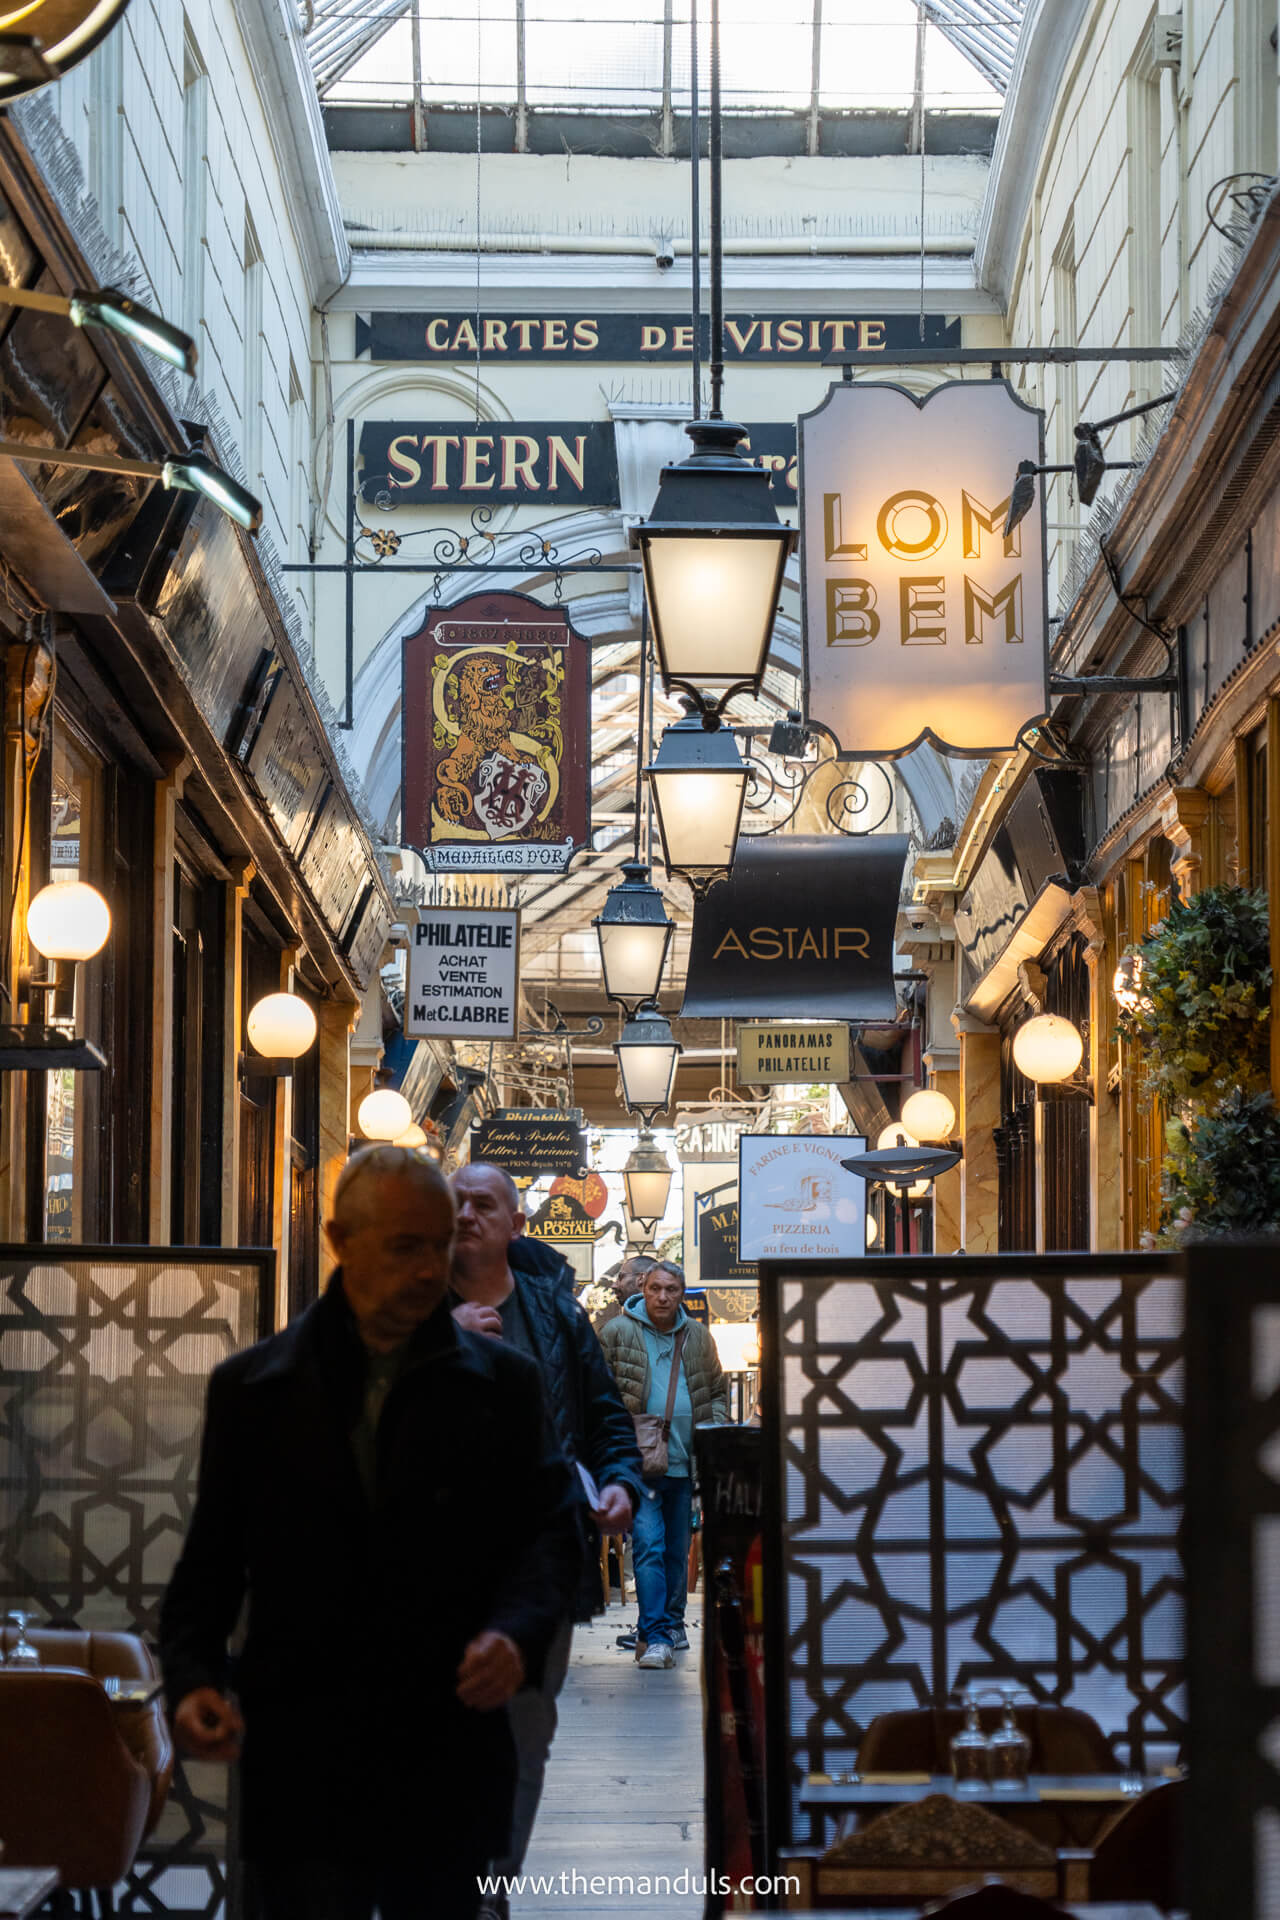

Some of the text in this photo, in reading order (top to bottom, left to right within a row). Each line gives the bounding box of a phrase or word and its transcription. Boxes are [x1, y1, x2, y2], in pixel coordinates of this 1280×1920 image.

[424, 318, 887, 353] CARTES DE VISITE
[386, 434, 588, 492] STERN
[823, 488, 1023, 562] LOM
[825, 573, 1025, 648] BEM
[435, 849, 566, 865] MEDAILLES D'OR
[712, 927, 871, 960] ASTAIR
[438, 955, 487, 968] ACHAT
[438, 970, 487, 984] VENTE
[421, 984, 503, 999] ESTIMATION
[757, 1033, 833, 1049] PANORAMAS
[757, 1056, 831, 1073] PHILATELIE
[748, 1143, 791, 1176] FARINE
[772, 1223, 832, 1236] PIZZERIA
[763, 1242, 840, 1255] au feu de bois
